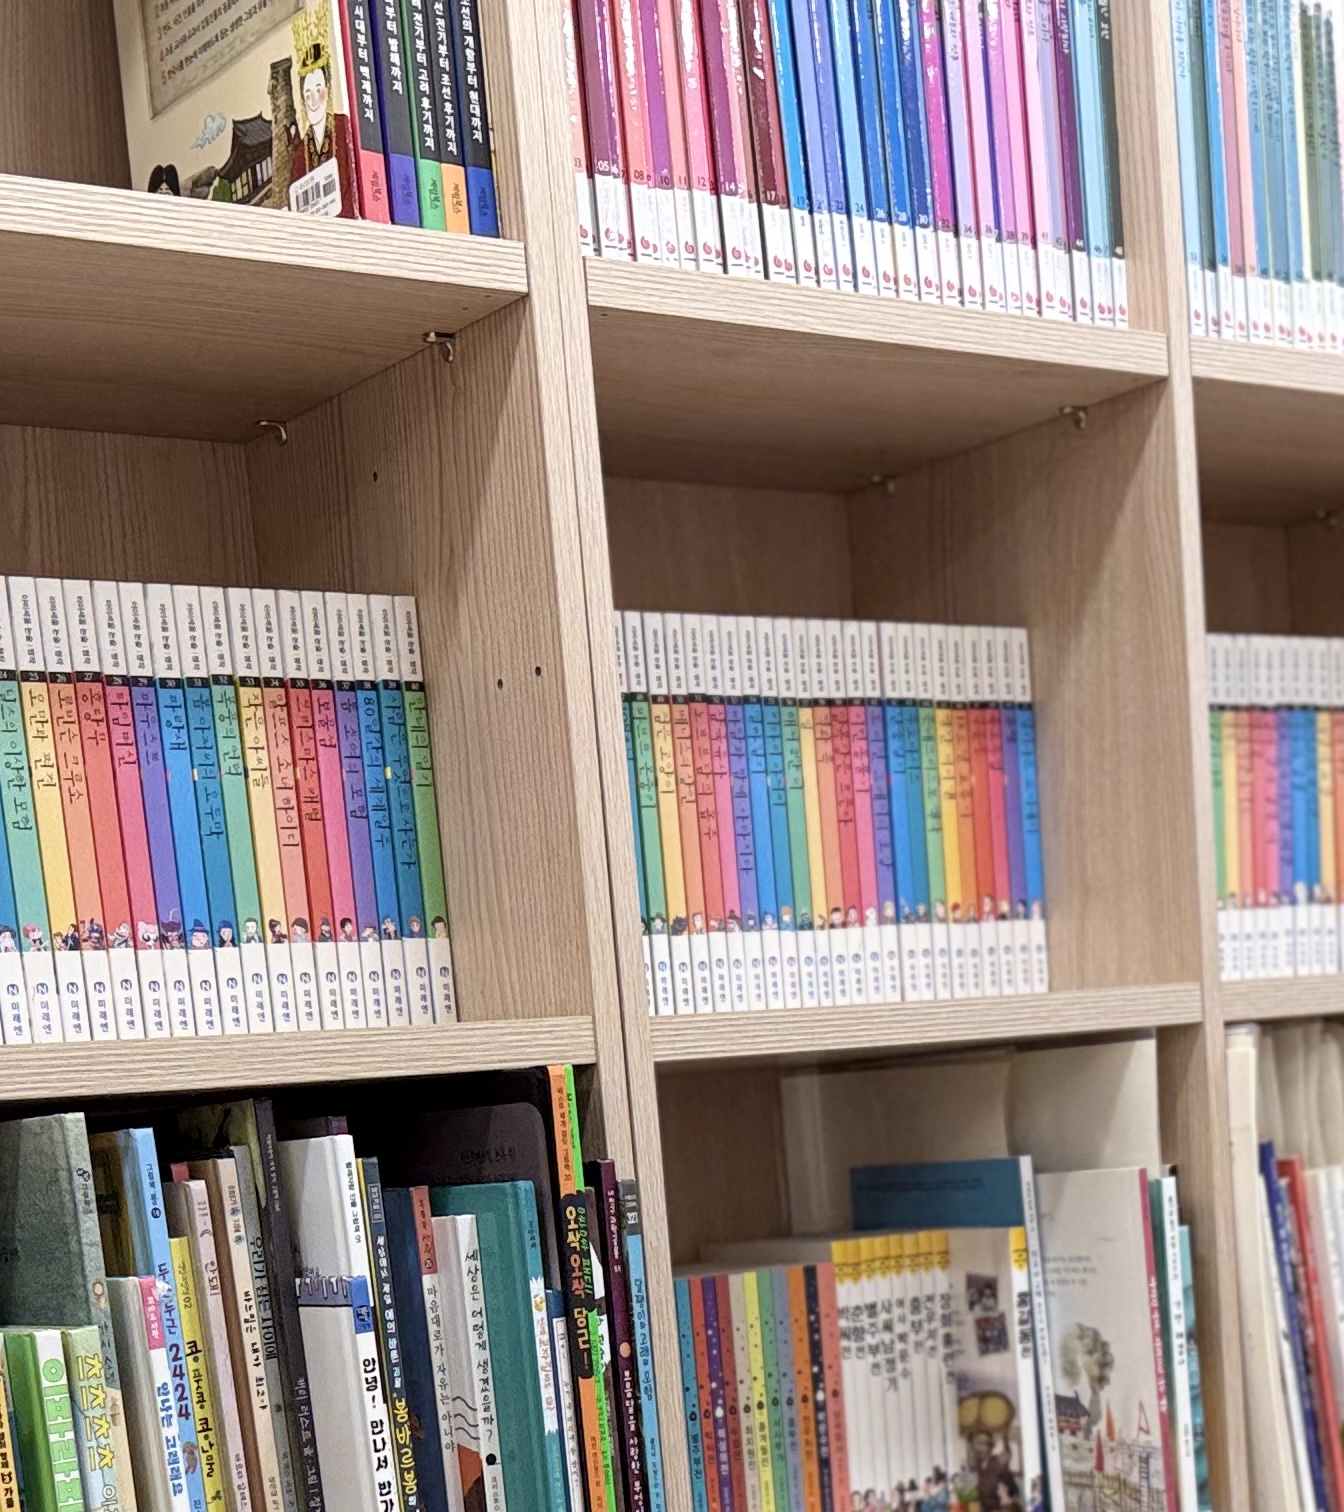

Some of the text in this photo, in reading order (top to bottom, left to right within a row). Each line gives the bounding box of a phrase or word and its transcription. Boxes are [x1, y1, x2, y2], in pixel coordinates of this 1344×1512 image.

[360, 65, 374, 122] 백제까지
[468, 90, 483, 143] 현대까지
[420, 97, 434, 151] 후기까지
[443, 102, 457, 155] 후기까지
[82, 688, 105, 747] 홍당무
[316, 696, 336, 750] 보물섬
[364, 696, 391, 849] 80일간의 세계일주
[464, 1249, 484, 1304] 세상은
[471, 1307, 488, 1353] 어떻게
[168, 1343, 191, 1421] 2424
[156, 1381, 184, 1498] 안나는 고래래요
[369, 1419, 388, 1473] 만나서
